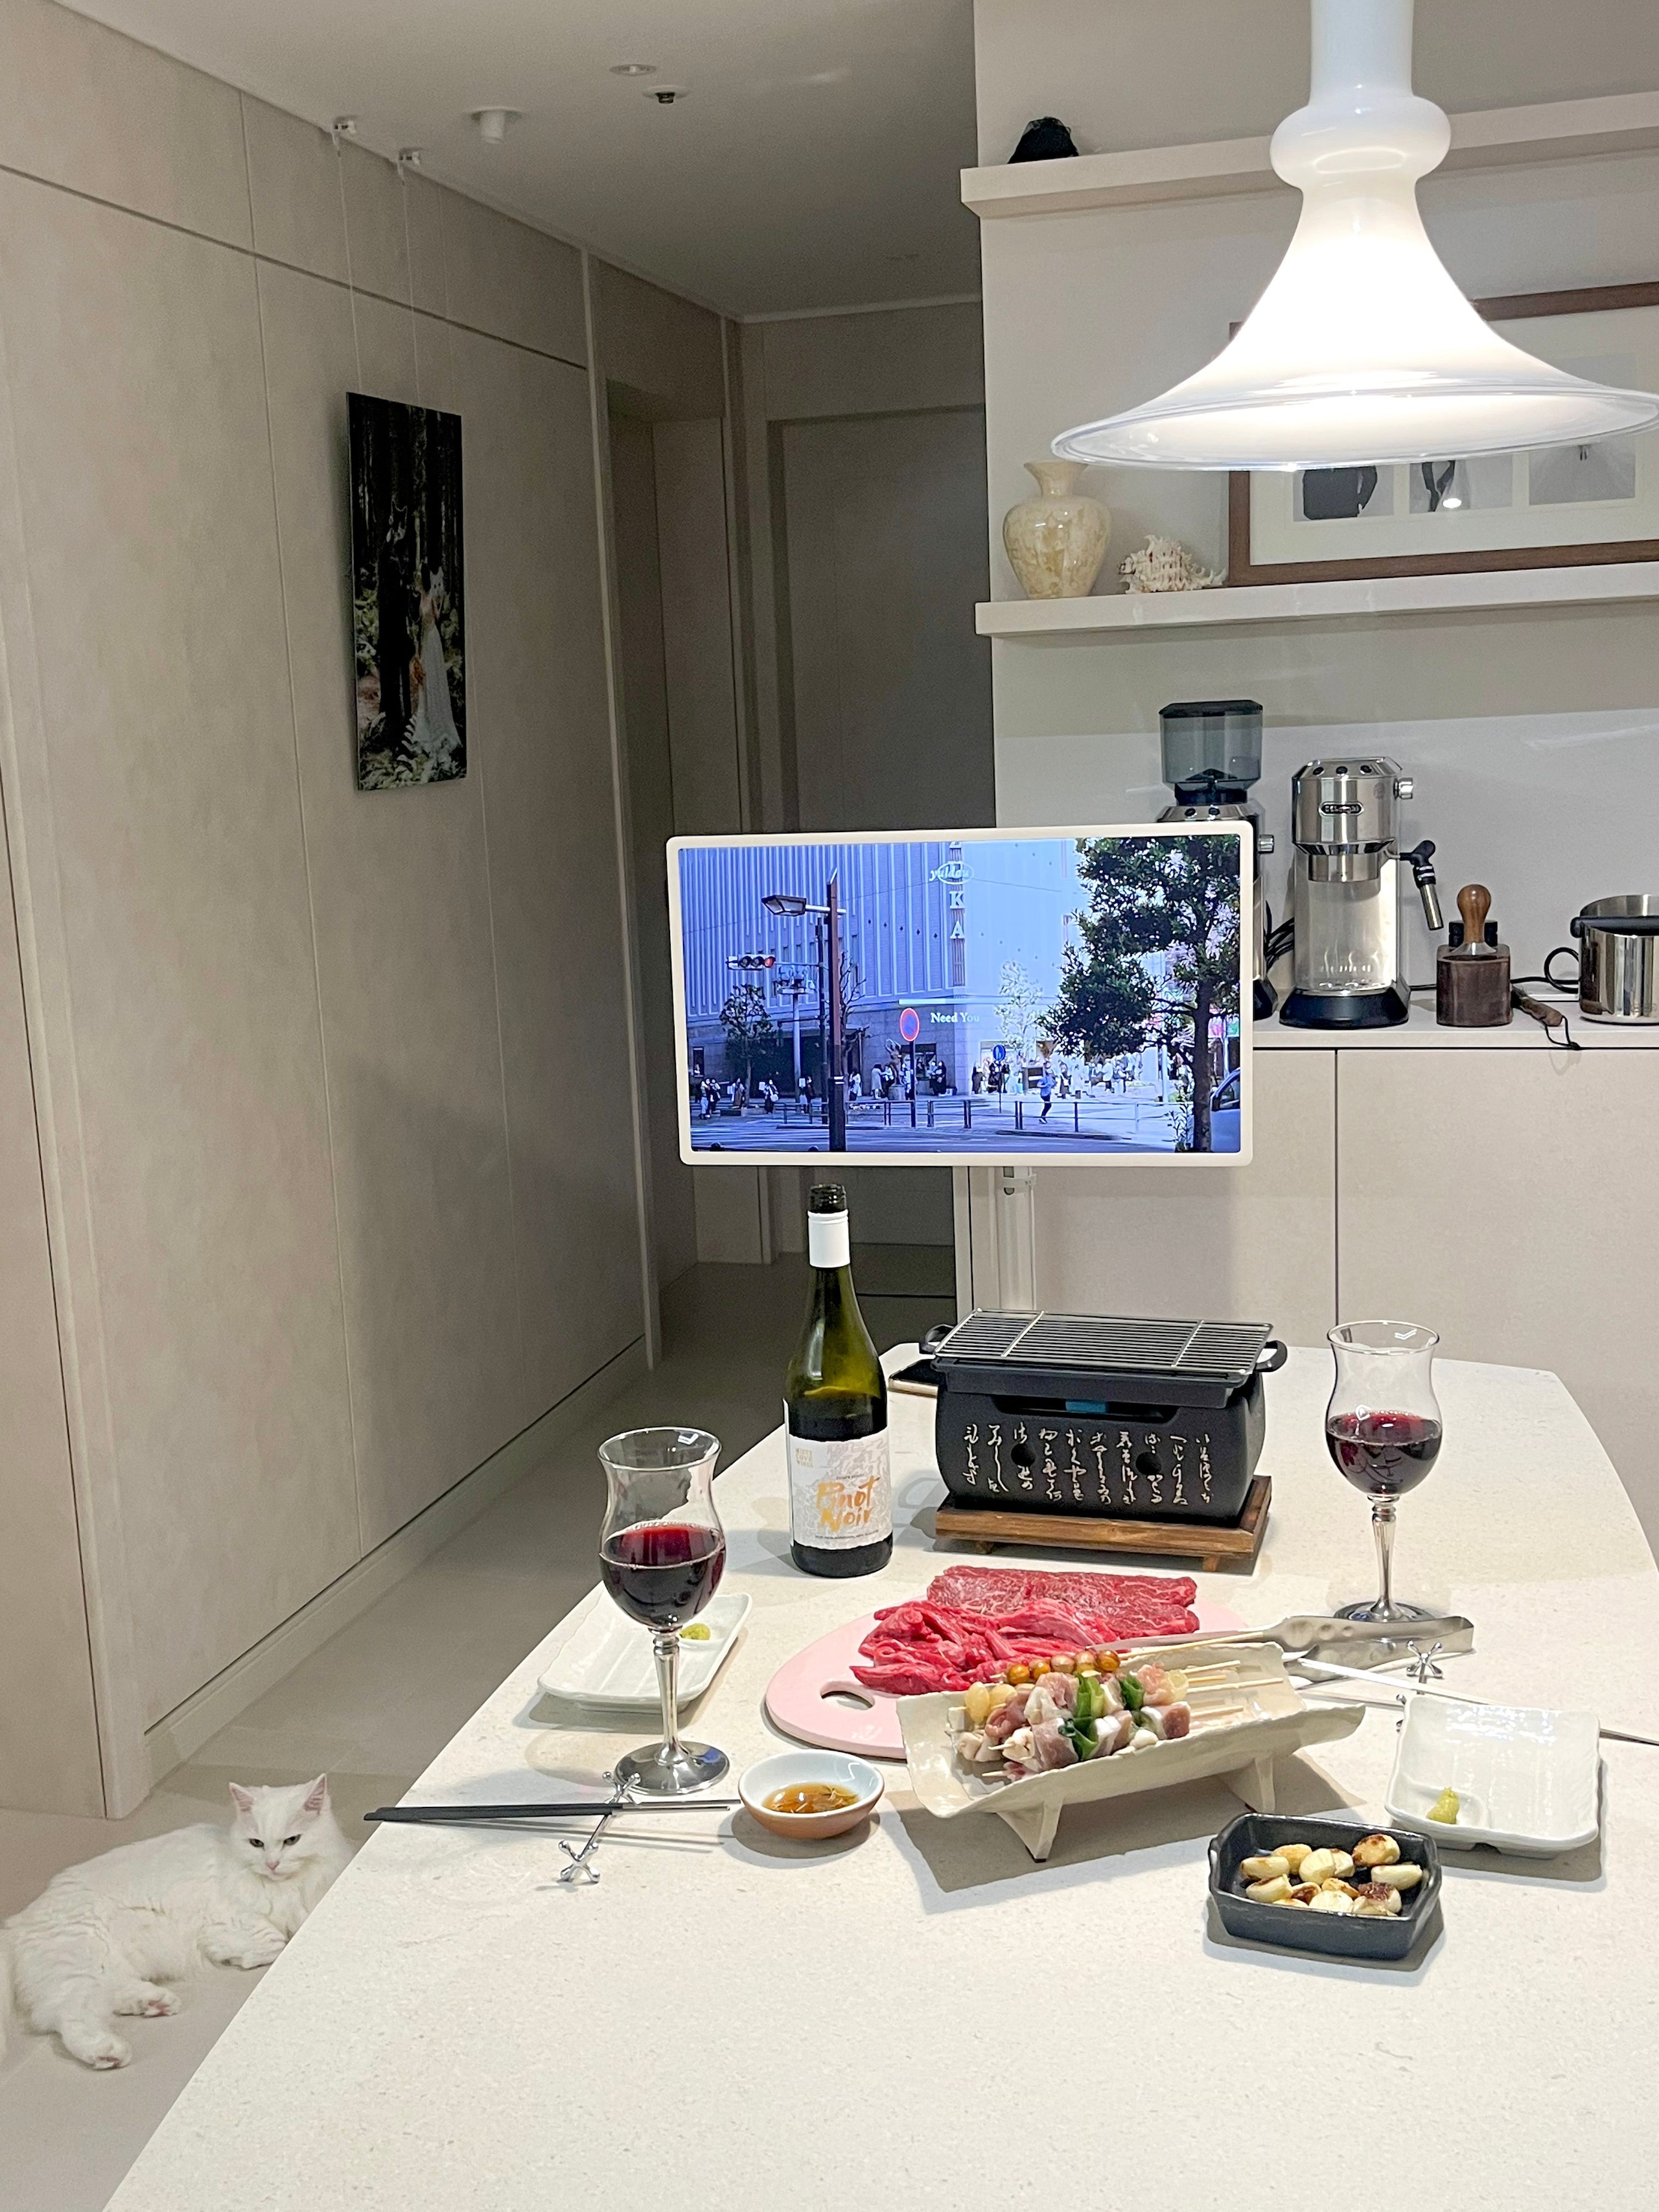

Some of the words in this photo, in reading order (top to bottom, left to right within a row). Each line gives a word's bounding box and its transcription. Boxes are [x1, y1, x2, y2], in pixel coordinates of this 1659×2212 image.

[930, 1012, 958, 1023] Need
[959, 1012, 980, 1023] You
[820, 1506, 874, 1532] Noir
